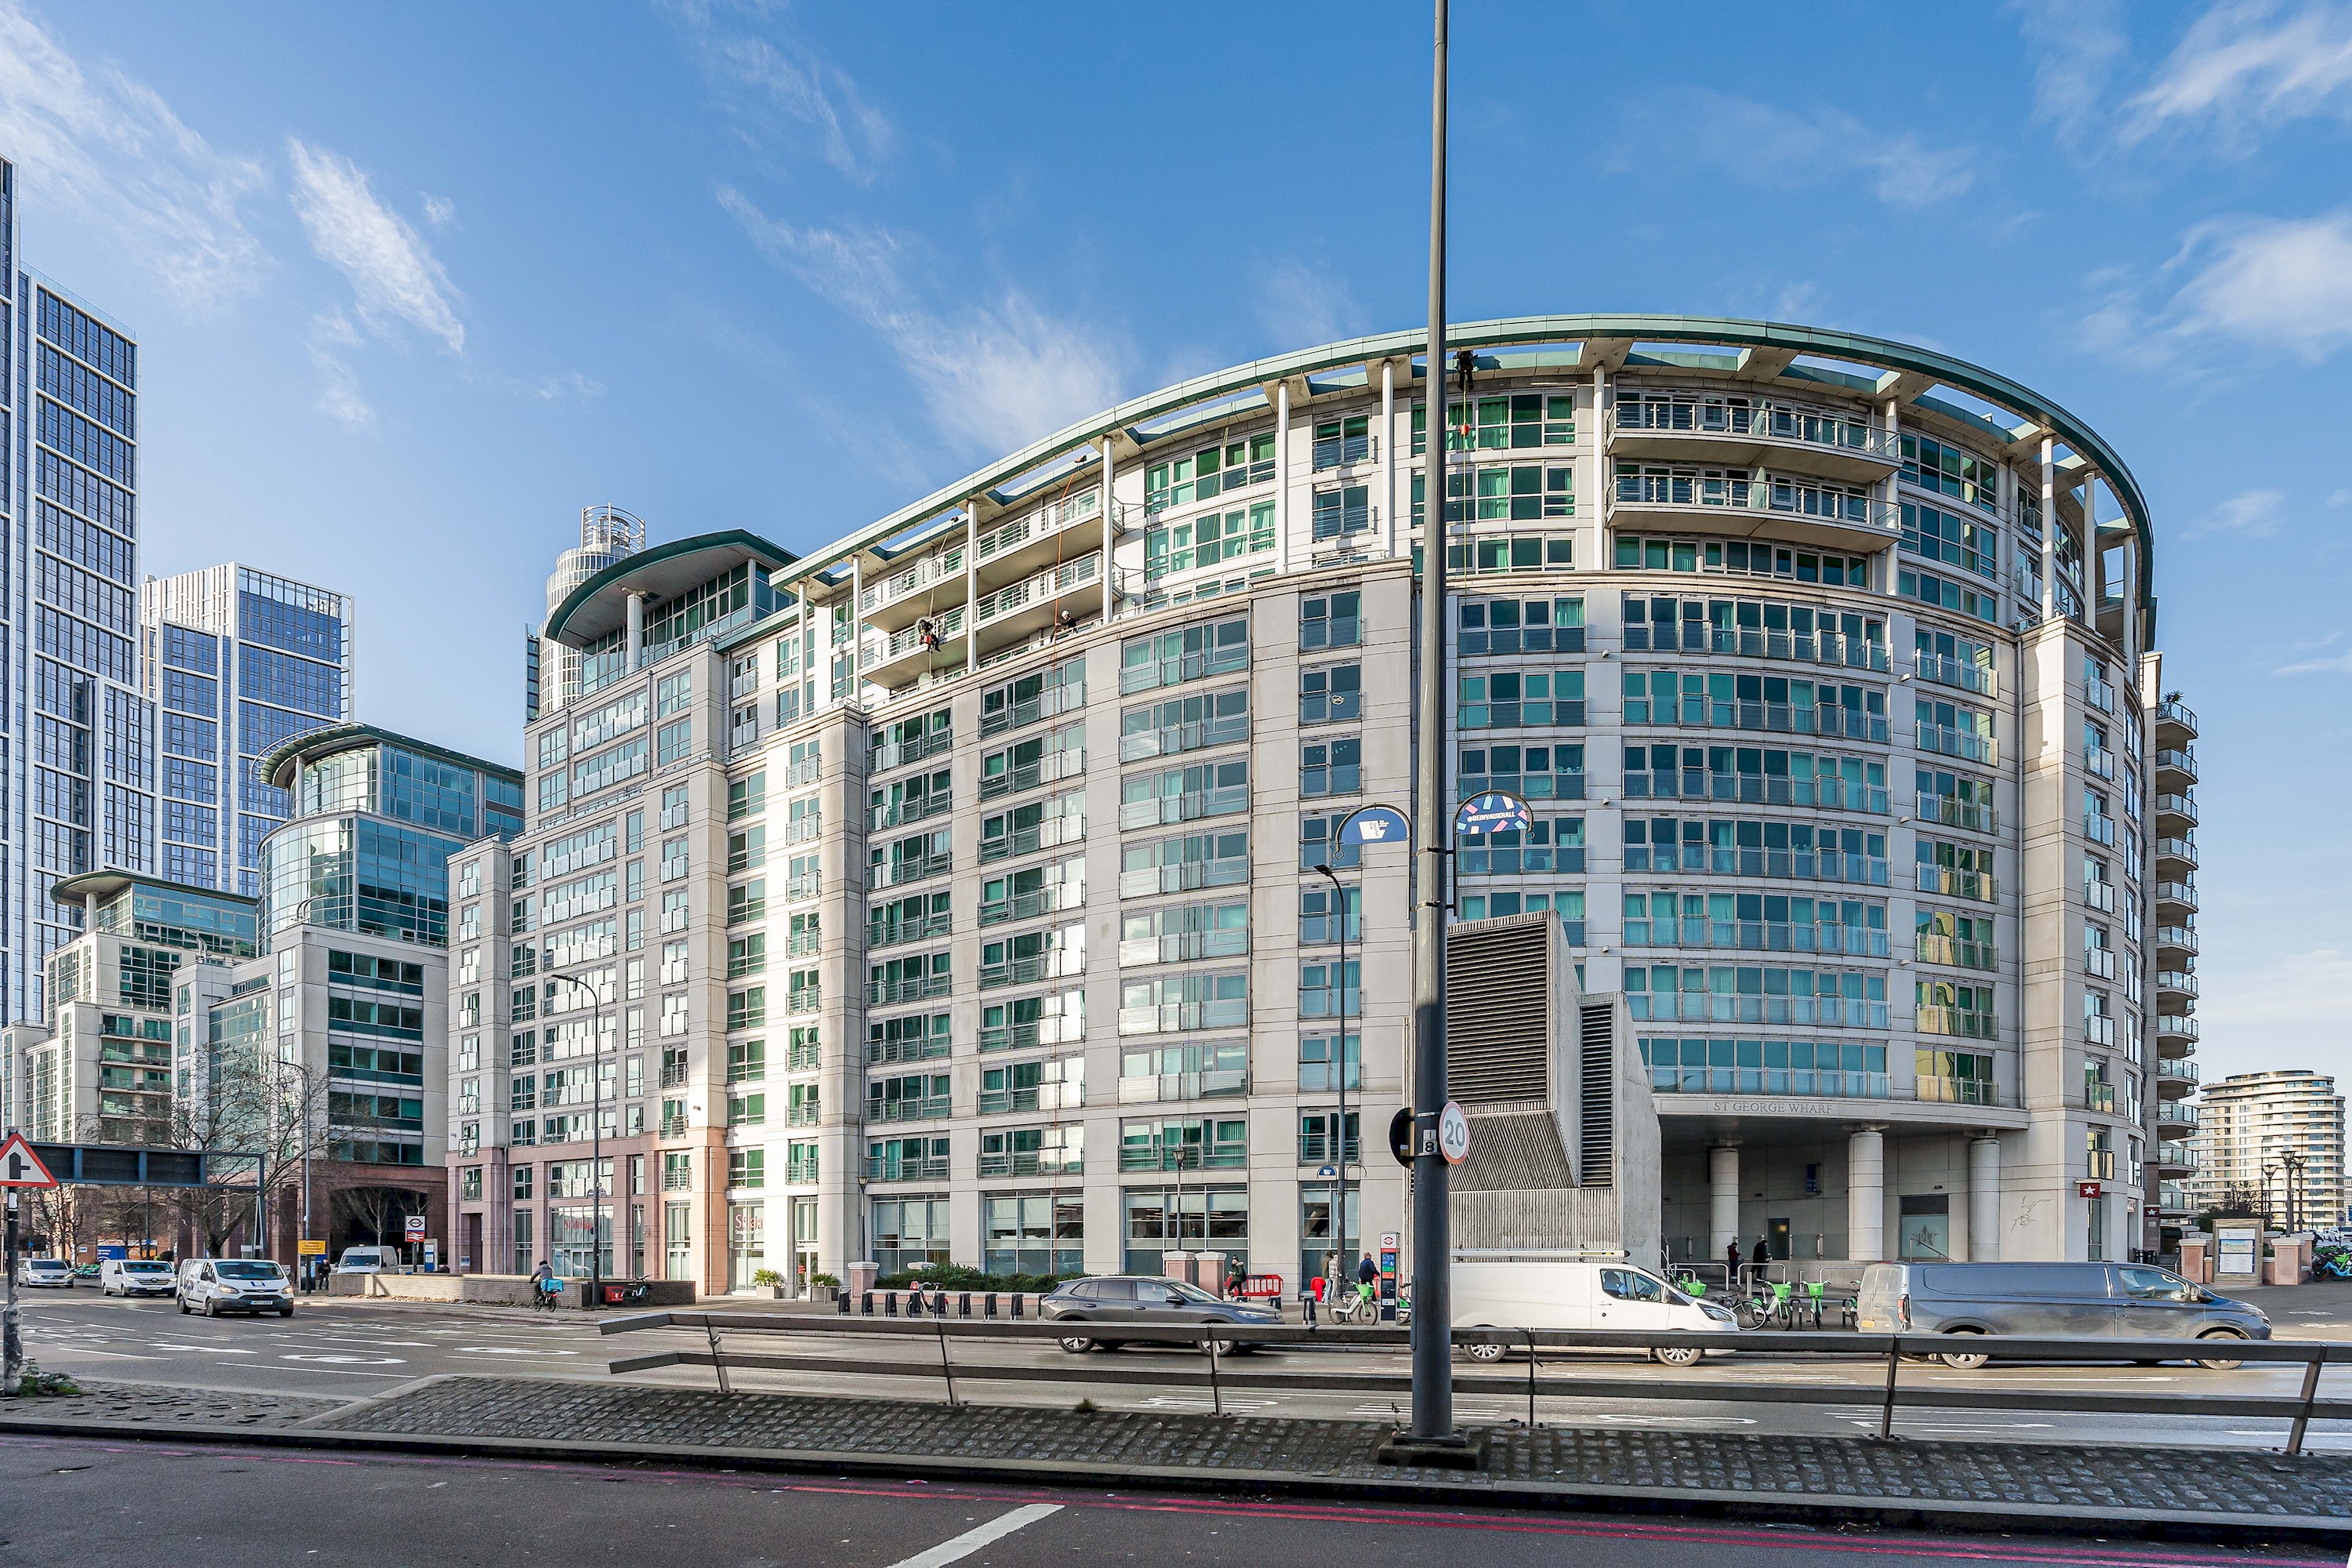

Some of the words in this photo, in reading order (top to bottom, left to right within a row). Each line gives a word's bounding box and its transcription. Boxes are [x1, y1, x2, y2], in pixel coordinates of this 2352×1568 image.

[1467, 811, 1515, 822] @BEINVAUXHALL
[1714, 1102, 1729, 1112] ST
[1733, 1102, 1785, 1112] GEORGE
[1788, 1103, 1833, 1114] WHARF
[1445, 1119, 1465, 1147] 20
[1425, 1141, 1435, 1152] 8
